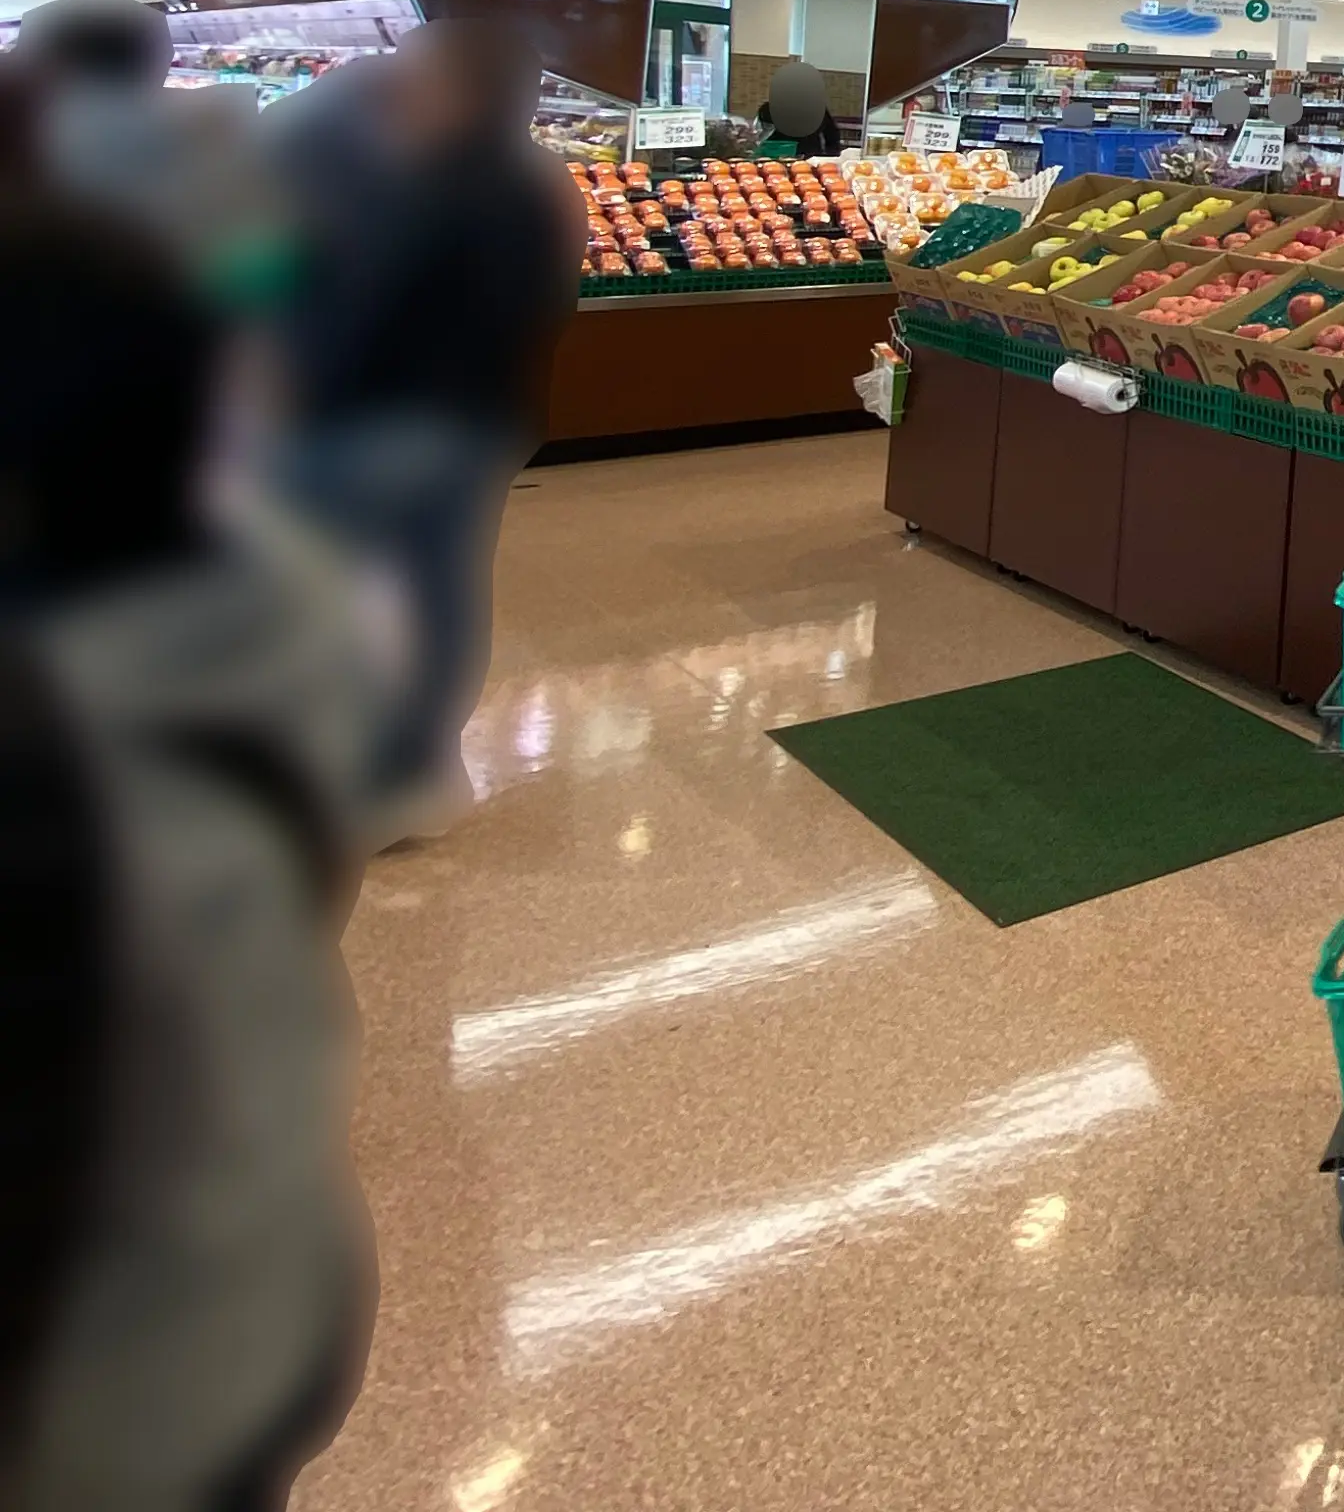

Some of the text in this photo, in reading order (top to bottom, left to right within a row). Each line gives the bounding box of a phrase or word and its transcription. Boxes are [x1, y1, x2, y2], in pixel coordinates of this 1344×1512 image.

[1251, 2, 1263, 18] 2
[664, 126, 694, 135] 299
[924, 130, 950, 139] 299
[663, 135, 694, 144] 323
[923, 138, 948, 147] 323
[1262, 144, 1280, 154] 159
[1260, 155, 1280, 165] 172
